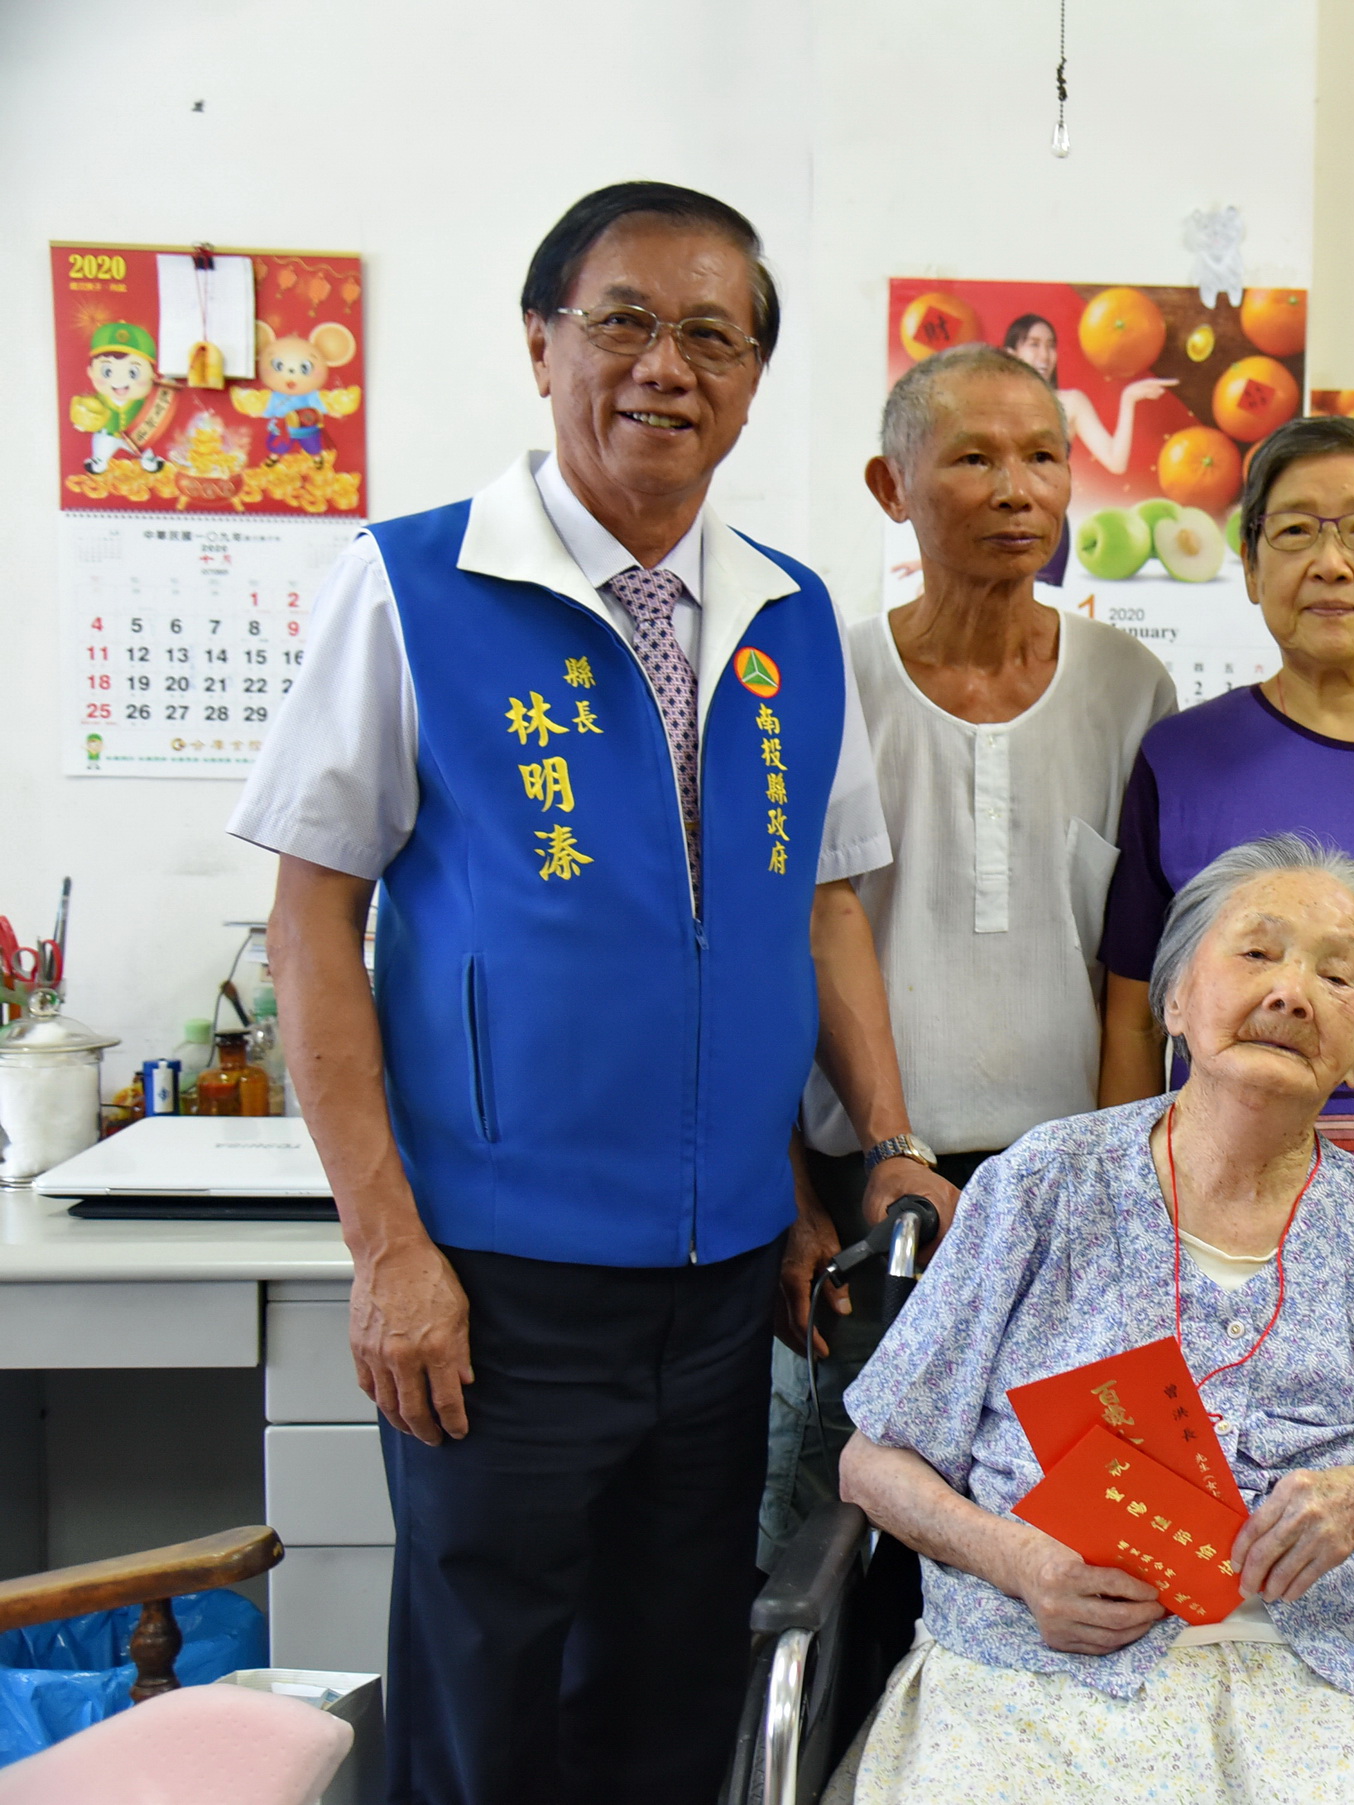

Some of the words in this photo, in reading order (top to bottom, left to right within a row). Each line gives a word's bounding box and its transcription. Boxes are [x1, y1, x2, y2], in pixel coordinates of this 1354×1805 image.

[68, 254, 126, 280] 2020
[250, 592, 259, 606] 1
[287, 593, 300, 607] 2
[1109, 608, 1145, 621] 2020
[91, 617, 104, 631] 4
[131, 618, 143, 633] 5
[170, 618, 182, 634] 6
[209, 620, 221, 635] 7
[248, 620, 261, 636] 8
[287, 621, 300, 636] 9
[1111, 623, 1179, 642] anuary
[86, 646, 109, 661] 11
[127, 647, 150, 662] 12
[166, 648, 189, 663] 13
[205, 649, 228, 664] 14
[244, 649, 267, 665] 15
[87, 675, 111, 690] 18
[127, 676, 150, 691] 19
[165, 676, 189, 692] 20
[204, 677, 227, 692] 21
[243, 678, 267, 693] 22
[282, 679, 294, 694] 2
[1194, 682, 1202, 695] 2
[562, 656, 604, 735] 縣長
[86, 704, 112, 719] 25
[126, 704, 151, 720] 26
[165, 705, 189, 721] 27
[204, 706, 229, 722] 28
[243, 707, 268, 722] 29
[505, 691, 594, 881] 林明溱
[756, 703, 791, 876] 南投縣政府
[1105, 1458, 1131, 1477] 祝
